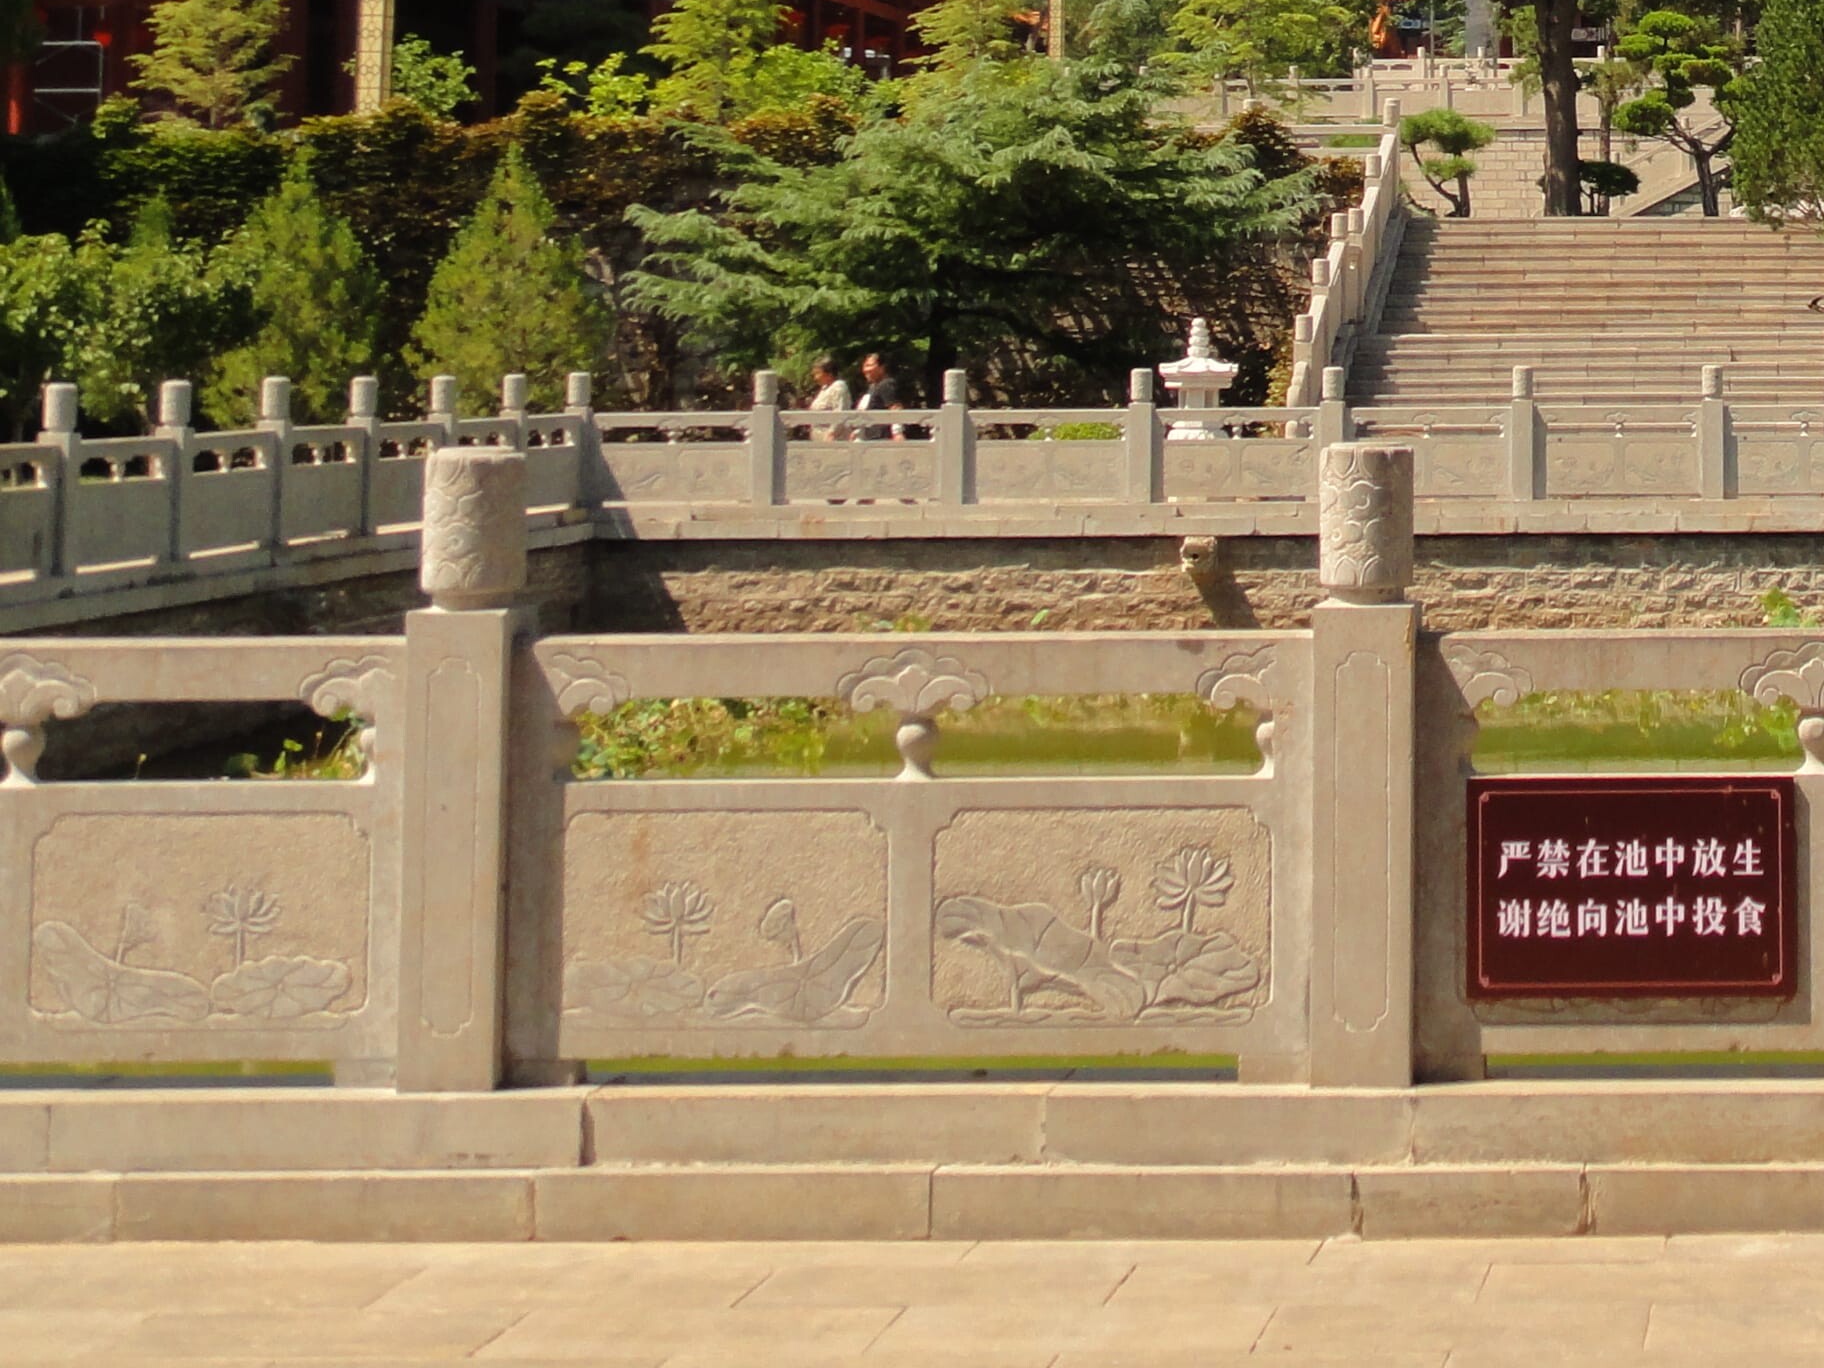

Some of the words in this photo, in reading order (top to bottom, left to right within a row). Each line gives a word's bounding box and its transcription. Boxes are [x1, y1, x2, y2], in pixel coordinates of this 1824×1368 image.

[1497, 837, 1765, 879] 严禁在池中放生
[1497, 896, 1767, 938] 谢绝向池中投食
